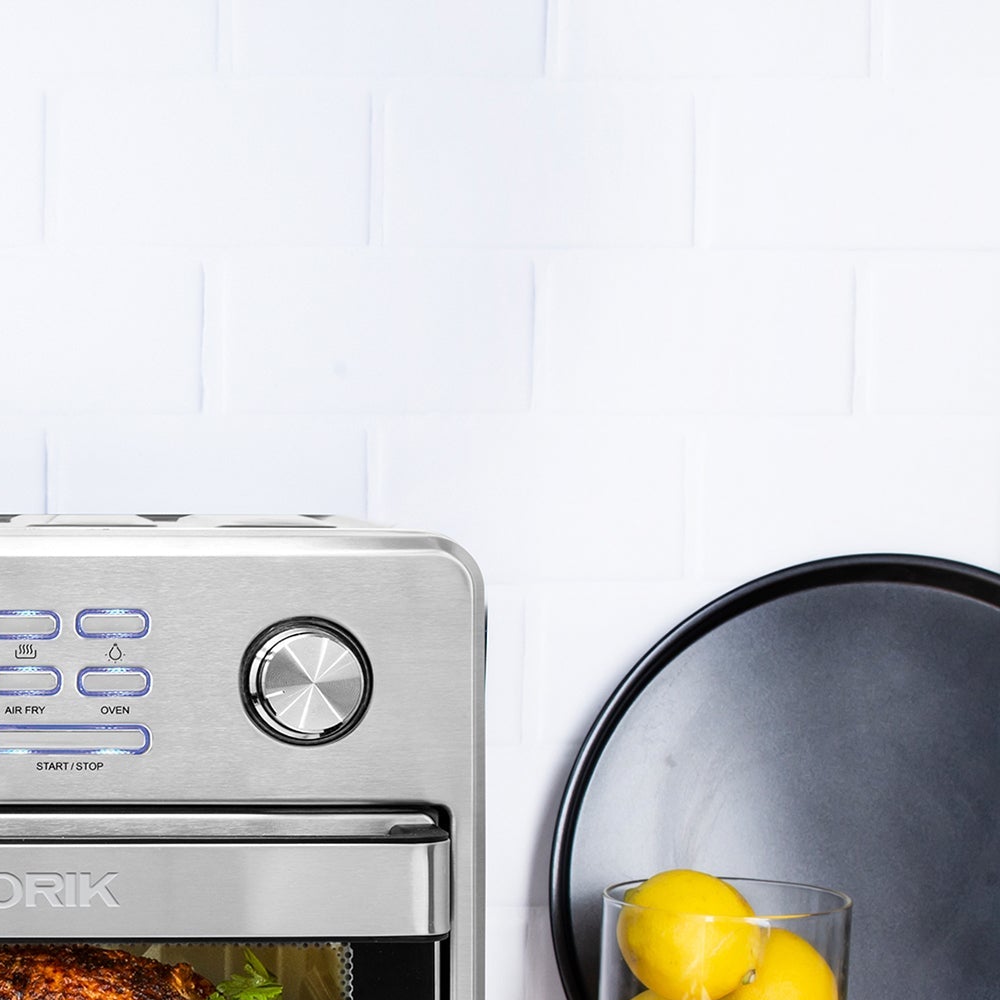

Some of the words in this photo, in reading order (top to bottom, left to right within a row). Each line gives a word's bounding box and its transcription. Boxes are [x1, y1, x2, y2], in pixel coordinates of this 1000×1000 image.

[5, 706, 22, 714] AIR
[25, 706, 45, 714] FRY
[100, 706, 130, 714] OVEN
[36, 762, 68, 771] START
[76, 762, 103, 771] STOP
